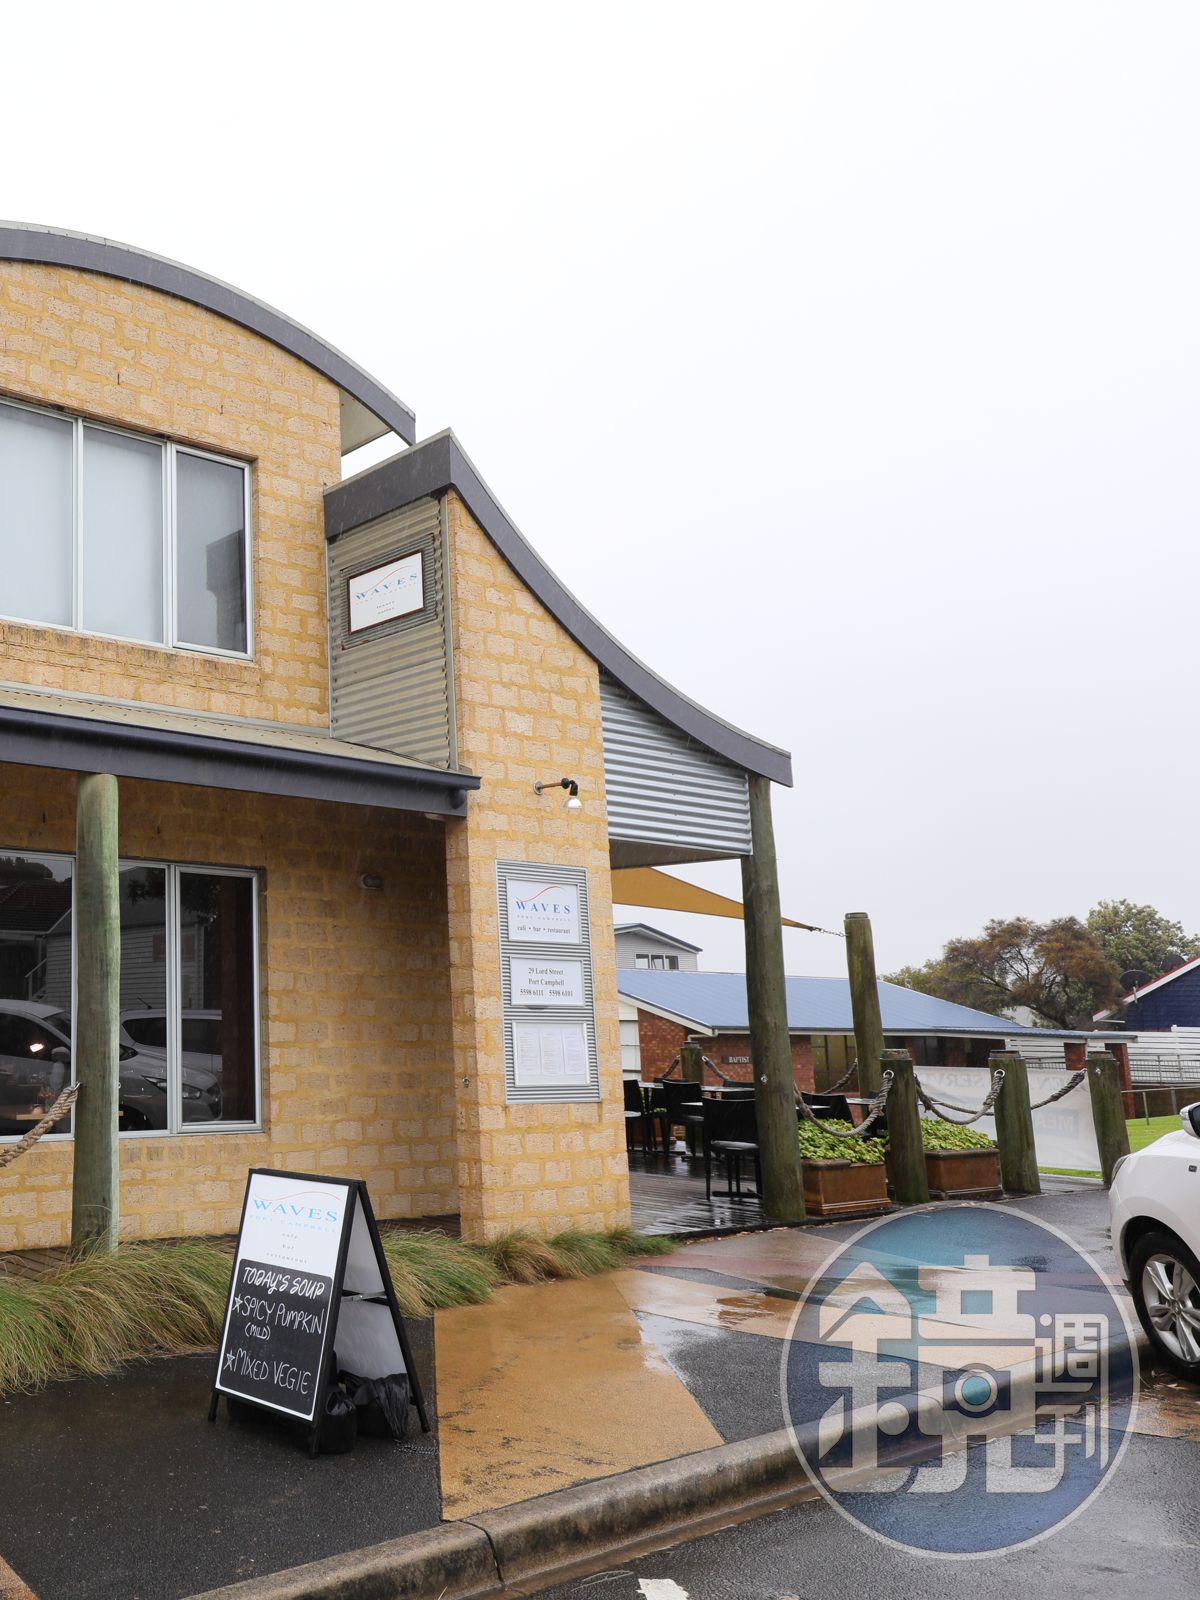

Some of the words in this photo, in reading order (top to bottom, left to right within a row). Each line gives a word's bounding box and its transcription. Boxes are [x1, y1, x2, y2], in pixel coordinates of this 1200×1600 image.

[516, 901, 571, 914] WAVES
[548, 968, 564, 976] Street
[540, 979, 565, 987] Campbell
[728, 1056, 750, 1064] BAPTIST
[253, 1199, 338, 1223] WAVES
[242, 1267, 290, 1295] TODAY'S
[289, 1277, 325, 1300] SOUP
[241, 1295, 276, 1324] SPICY
[275, 1303, 325, 1335] PUMPKIN
[244, 1321, 271, 1341] (MILD)
[233, 1347, 269, 1381] MIXED
[273, 1360, 312, 1395] VEGIE
